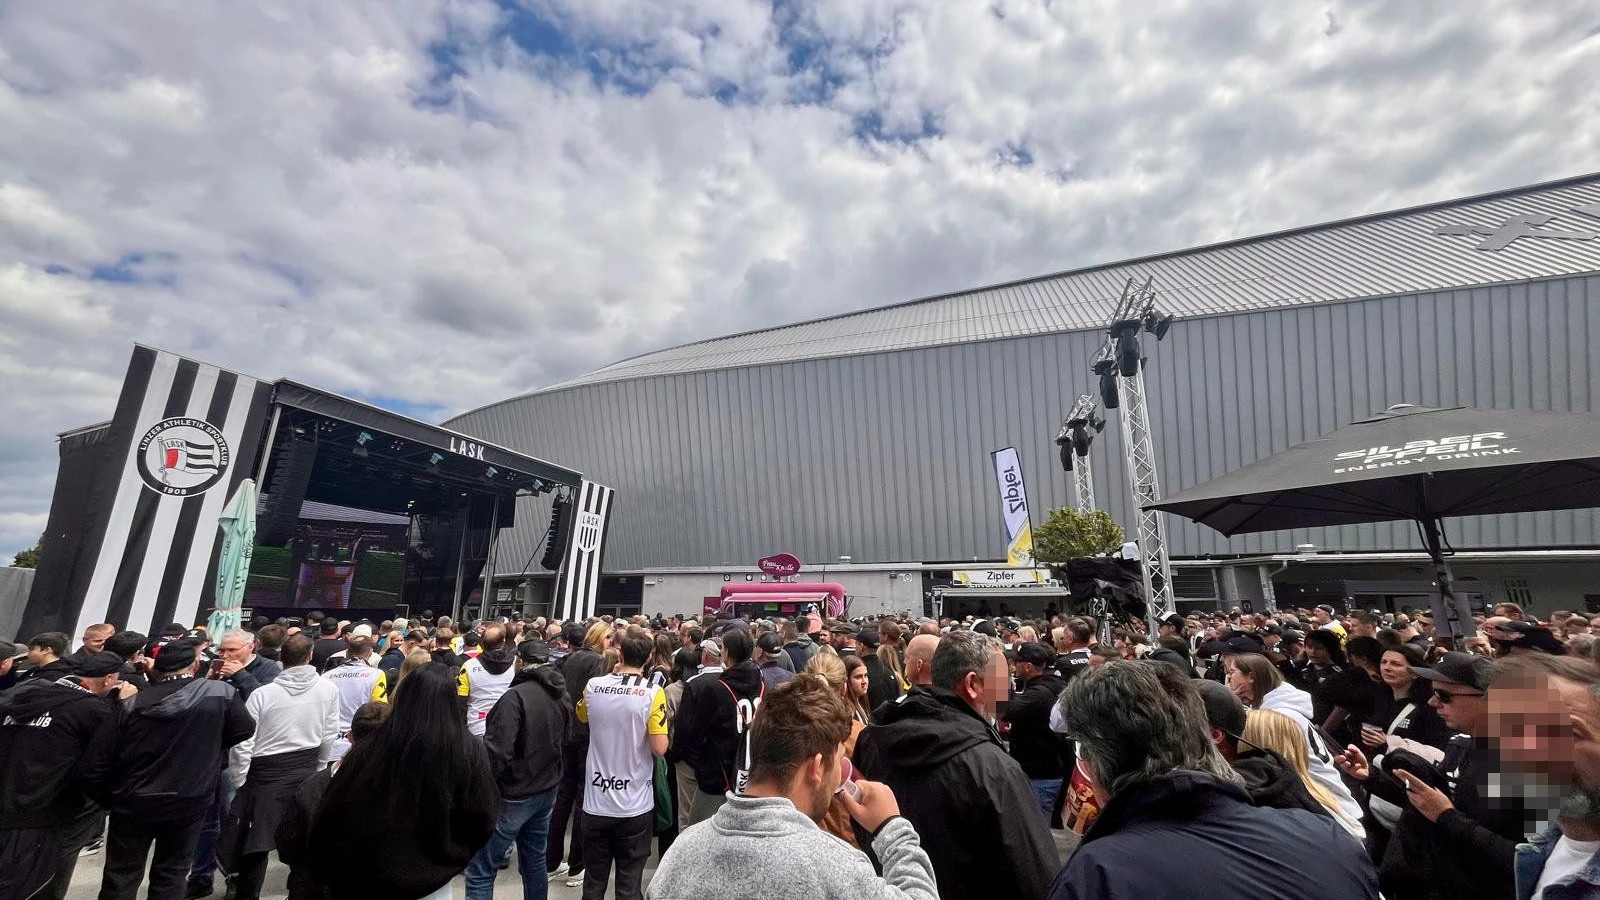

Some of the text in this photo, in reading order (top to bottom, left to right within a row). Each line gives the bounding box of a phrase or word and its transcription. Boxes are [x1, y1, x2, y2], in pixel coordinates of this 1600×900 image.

[140, 419, 228, 466] LINZER ATHLETIK SPORTKLUB
[166, 440, 185, 449] LASK
[450, 437, 486, 461] LASK
[1334, 431, 1508, 461] SILBER
[1363, 441, 1499, 463] PFEIL
[1334, 447, 1521, 474] ENERGY DRINK
[163, 486, 187, 495] 1908
[582, 515, 600, 527] LASK
[987, 571, 1016, 583] Zipfer
[592, 771, 630, 793] Zipfer
